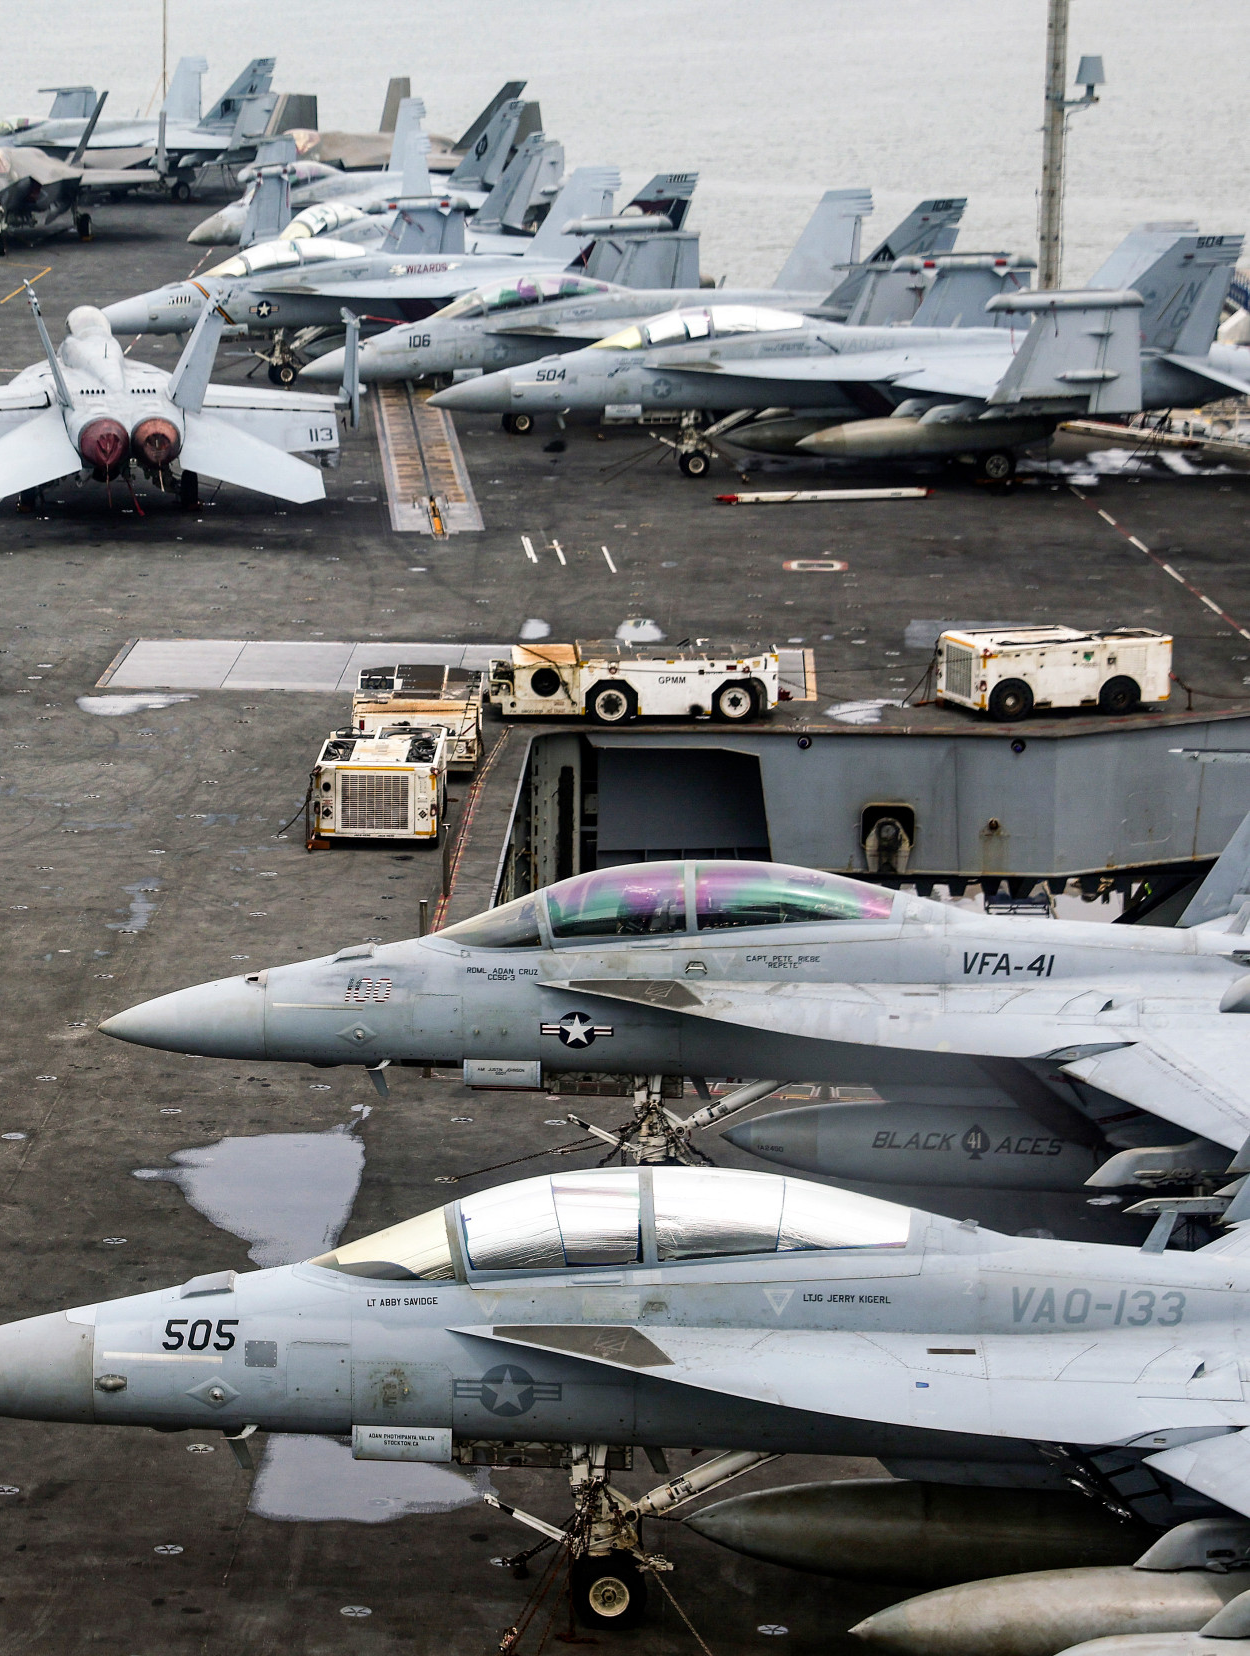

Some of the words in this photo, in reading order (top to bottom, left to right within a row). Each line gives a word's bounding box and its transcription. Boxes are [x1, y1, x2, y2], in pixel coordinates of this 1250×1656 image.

[1196, 236, 1224, 249] 504
[405, 262, 448, 275] WIZARDS
[409, 334, 431, 348] 106
[536, 369, 567, 382] 504
[309, 427, 333, 442] 113
[658, 676, 687, 684] GPMM
[963, 951, 1055, 977] VFA-41
[487, 973, 516, 981] CCSG-3
[492, 967, 514, 975] ADAN
[518, 968, 538, 976] CRUZ
[344, 977, 392, 1003] 100
[872, 1131, 958, 1151] BLACK
[967, 1131, 982, 1149] 41
[994, 1137, 1064, 1157] ACES
[367, 1299, 377, 1307] LT
[380, 1298, 401, 1306] ABBY
[403, 1297, 438, 1306] SAVIDGE
[803, 1293, 823, 1303] LTJG
[826, 1294, 855, 1303] JERRY
[858, 1295, 891, 1304] KIGERL
[162, 1319, 240, 1351] 505
